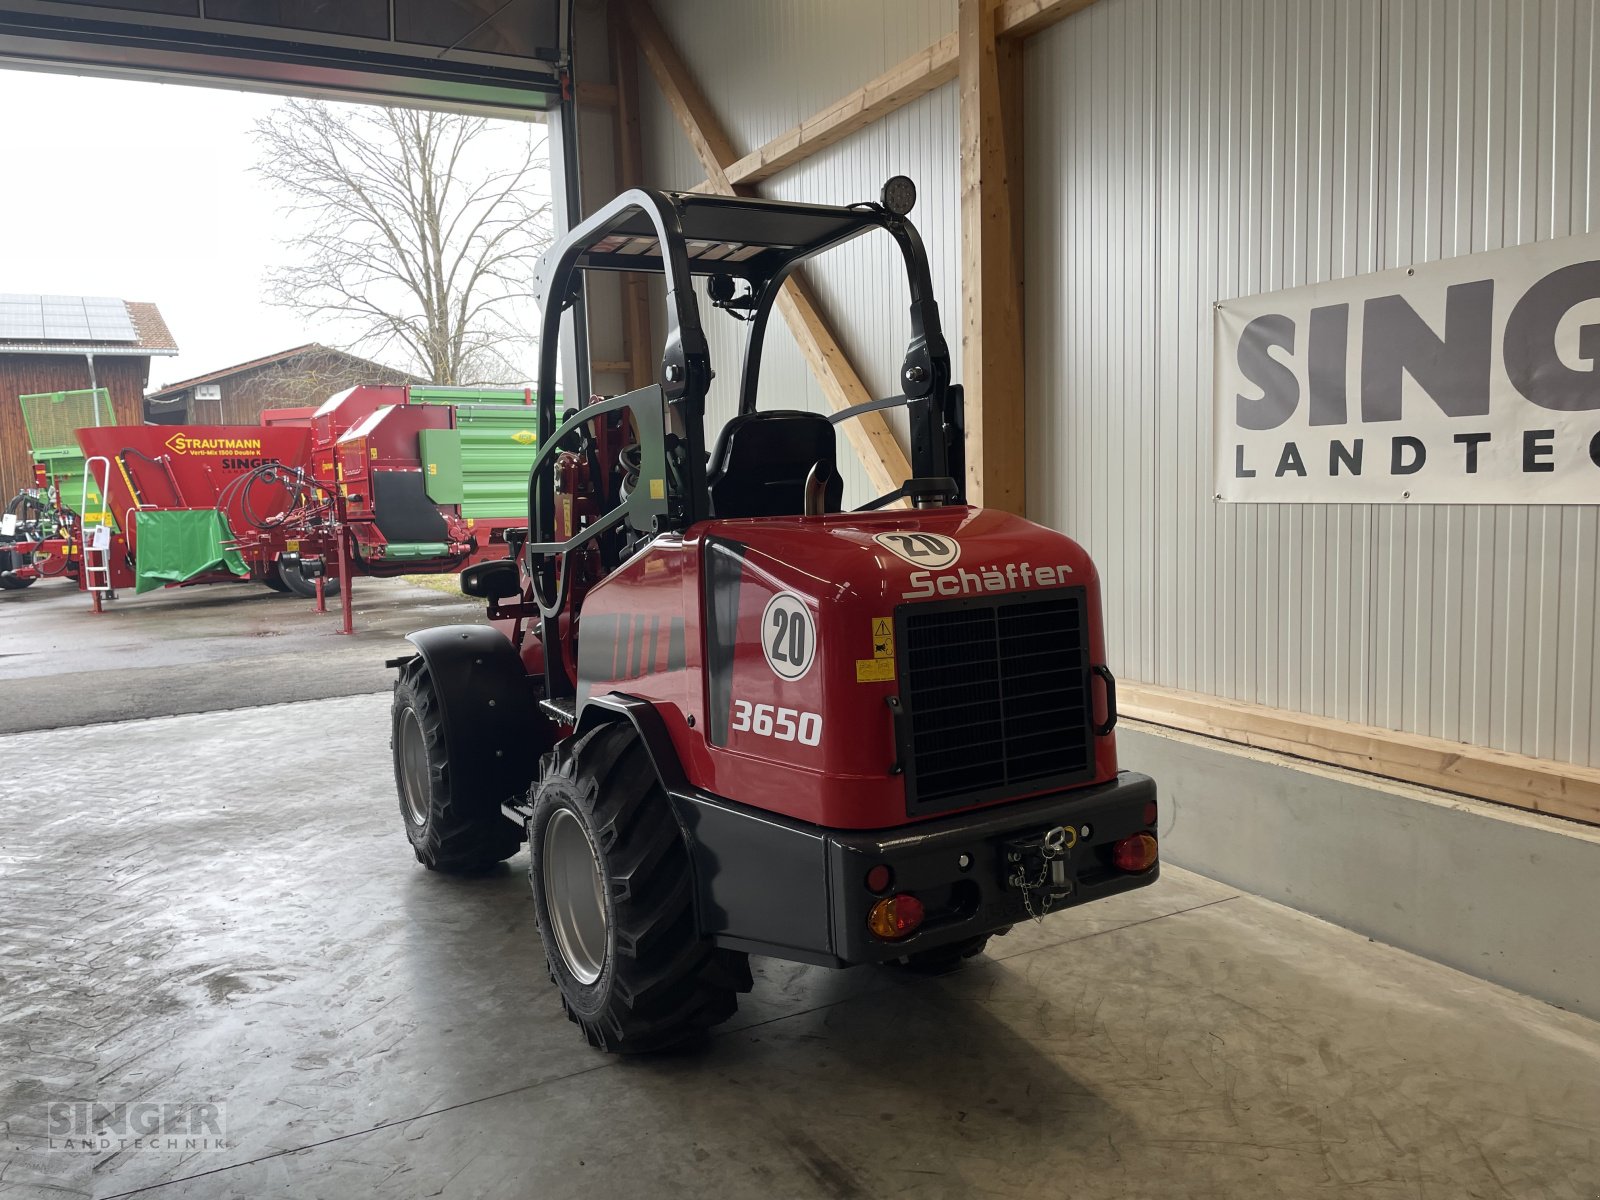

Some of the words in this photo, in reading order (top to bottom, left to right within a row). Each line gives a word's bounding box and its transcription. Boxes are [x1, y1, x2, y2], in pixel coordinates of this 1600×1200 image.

[175, 438, 261, 449] STRAUTMANN
[1236, 429, 1600, 478] LANDTE
[894, 533, 951, 557] 20
[901, 562, 1073, 599] Schäffer
[772, 607, 805, 667] 20
[732, 699, 823, 747] 3650
